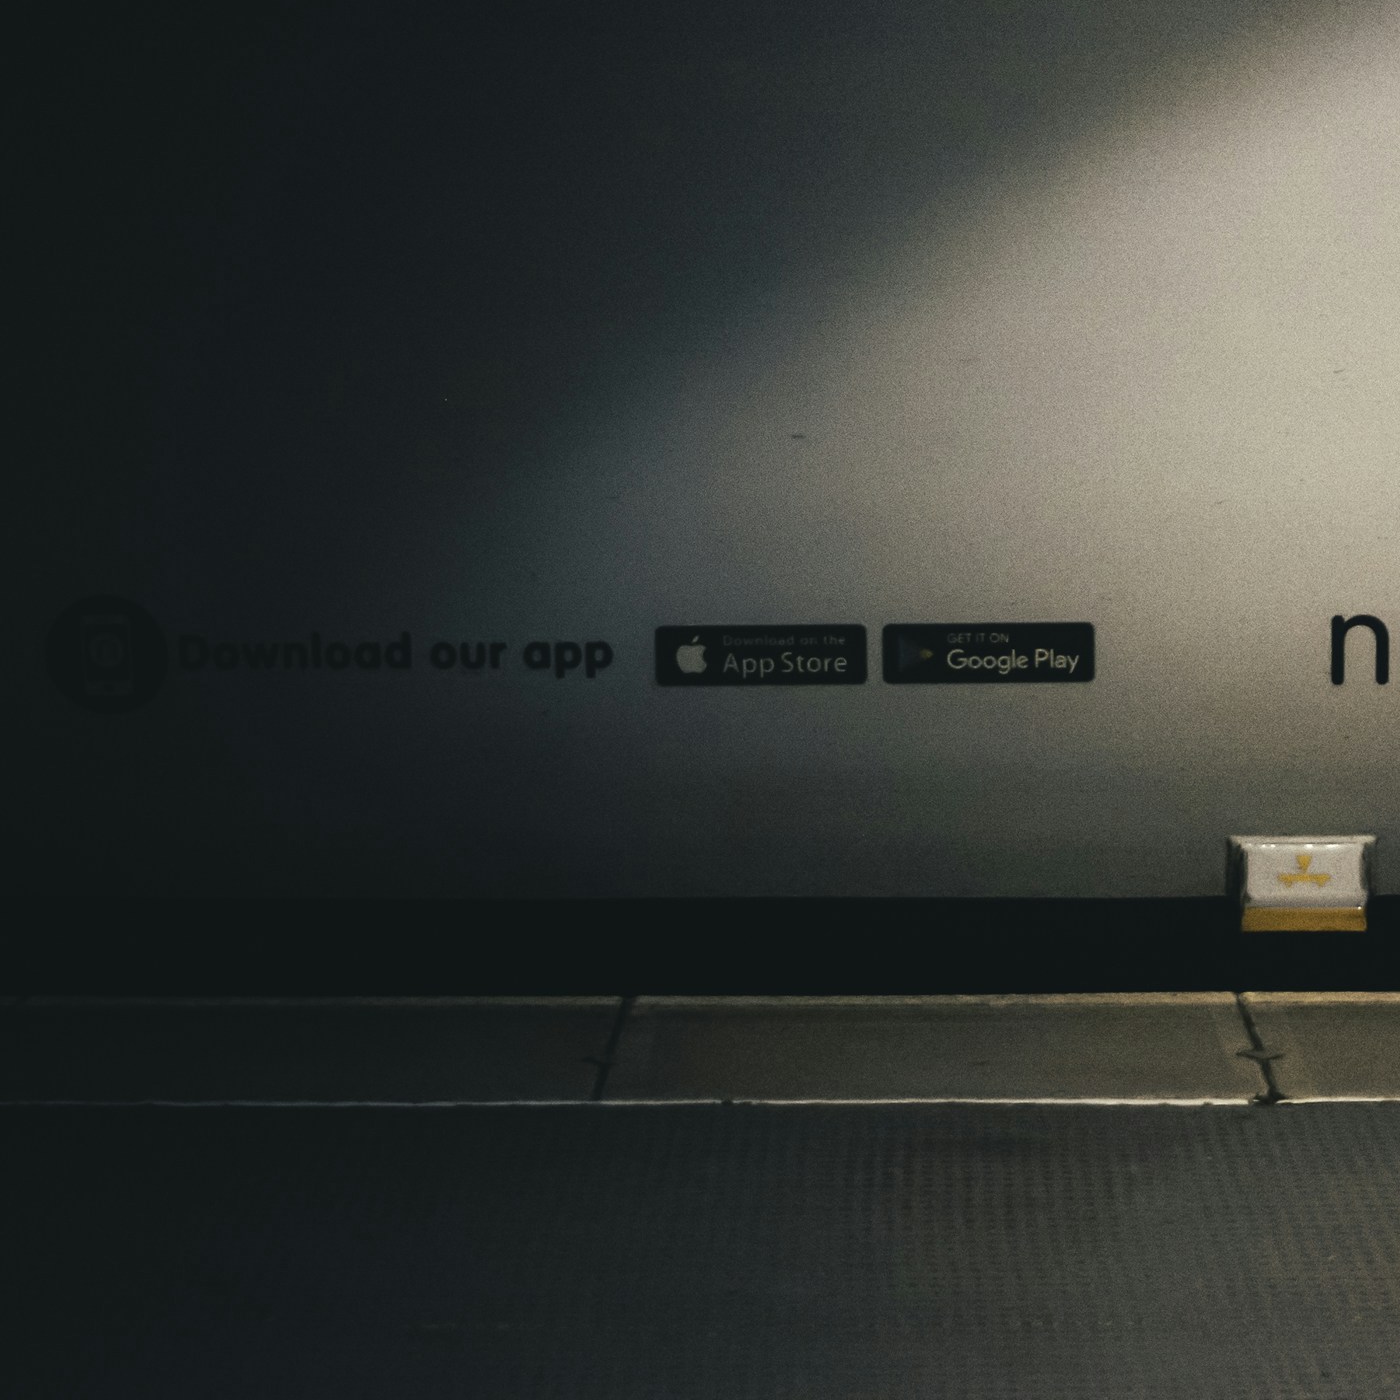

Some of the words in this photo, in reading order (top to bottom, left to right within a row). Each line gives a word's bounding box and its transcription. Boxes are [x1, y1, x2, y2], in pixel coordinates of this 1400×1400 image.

[722, 635, 795, 646] Download
[799, 637, 819, 646] on
[823, 635, 846, 646] the
[946, 632, 972, 644] GET
[975, 632, 986, 643] IT
[989, 632, 1010, 644] ON
[177, 631, 412, 672] Download
[429, 640, 508, 672] our
[522, 640, 615, 680] app
[722, 652, 776, 679] App
[780, 650, 848, 674] Store
[946, 648, 1029, 675] Google
[1034, 647, 1080, 674] Play
